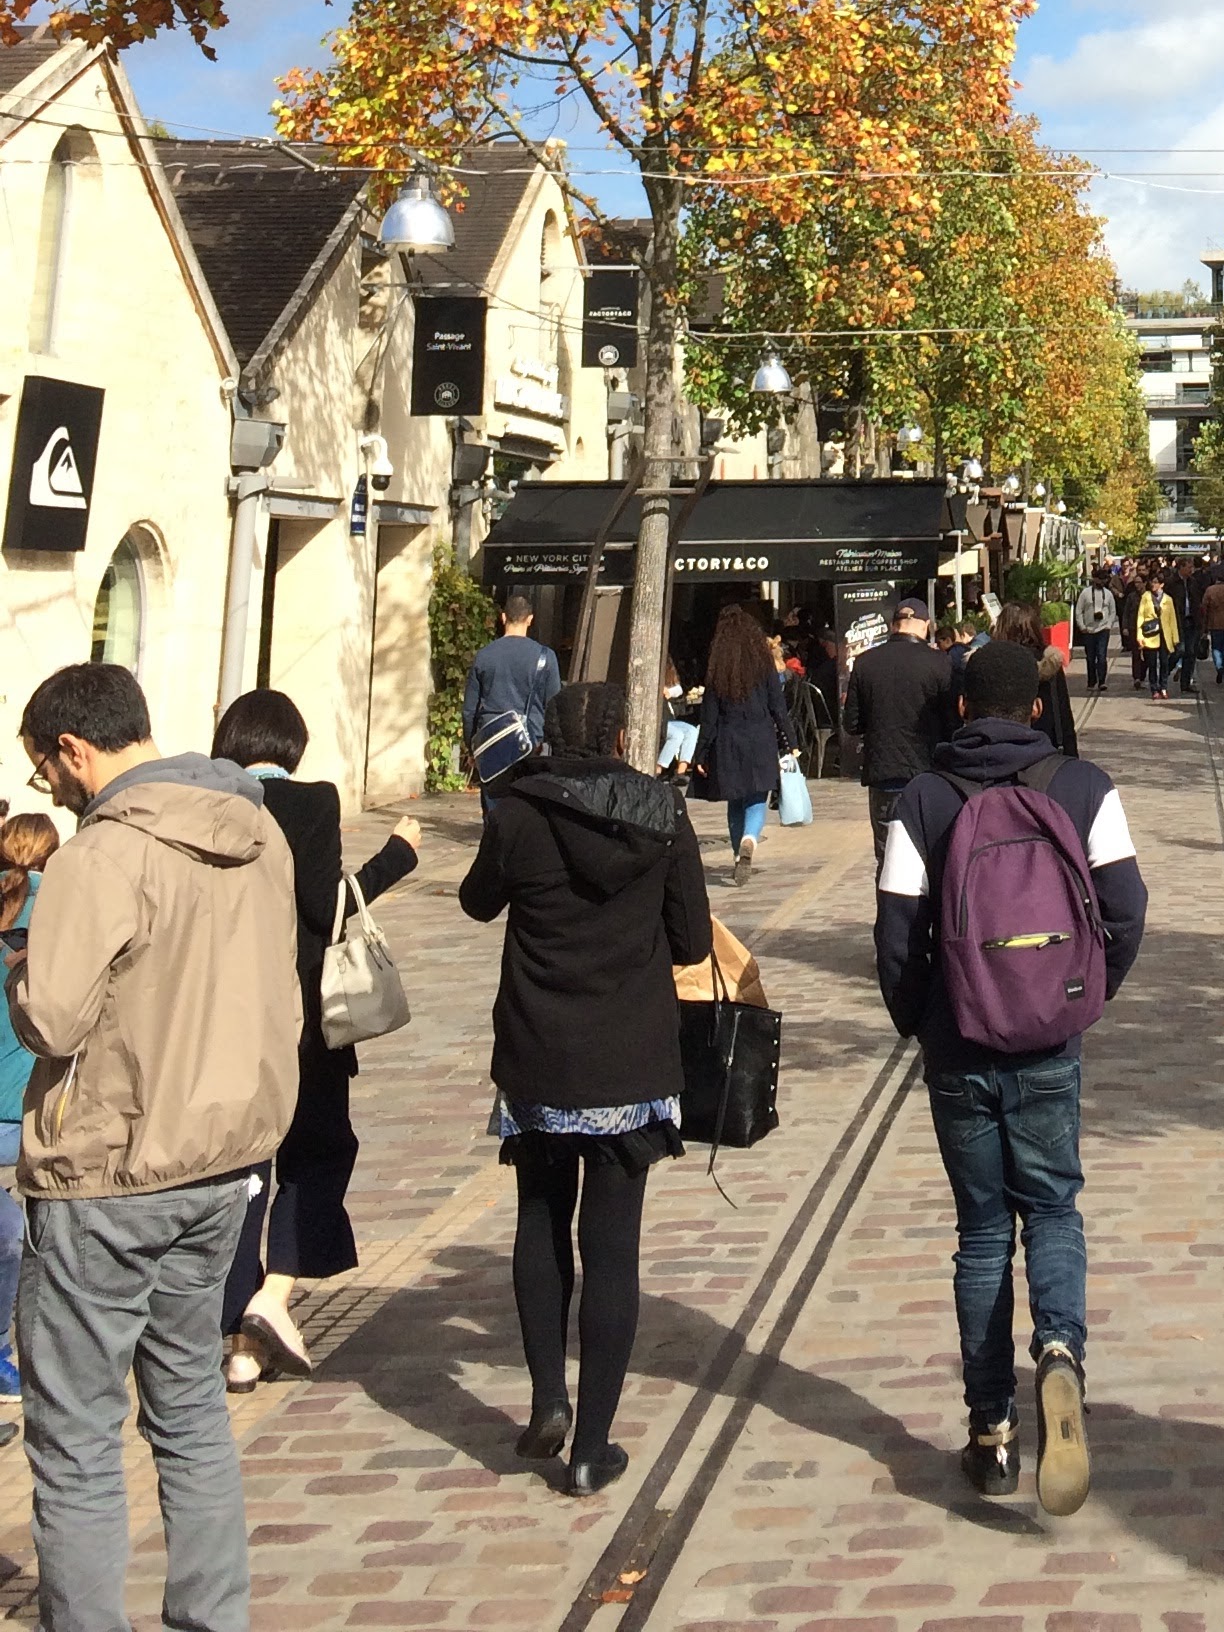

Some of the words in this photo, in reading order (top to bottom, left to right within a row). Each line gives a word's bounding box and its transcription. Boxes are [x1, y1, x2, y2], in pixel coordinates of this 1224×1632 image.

[434, 331, 466, 342] Passage
[516, 554, 539, 562] NEW
[542, 554, 569, 562] YORK
[572, 554, 592, 562] CIT
[674, 555, 769, 571] CTORY&CO
